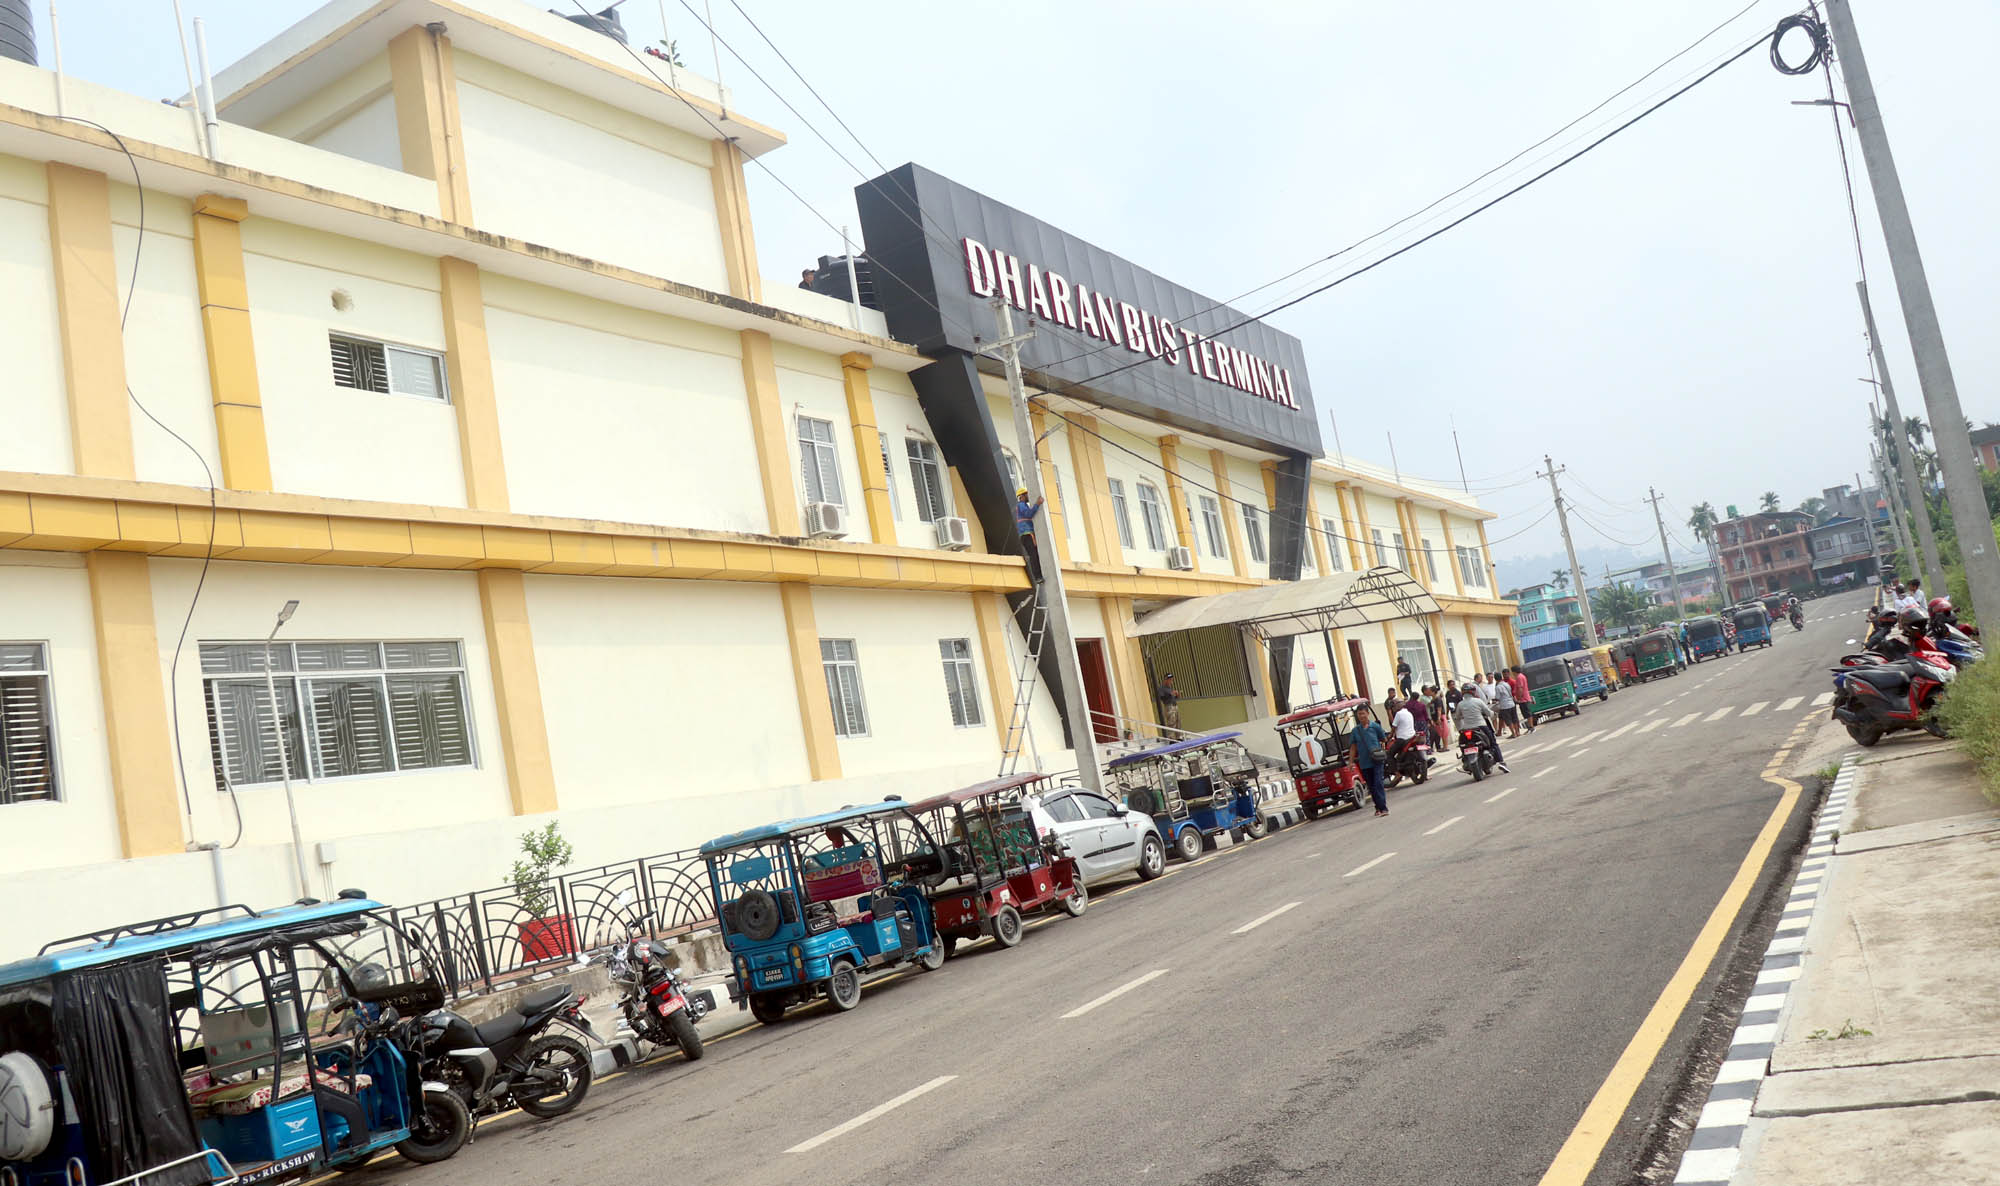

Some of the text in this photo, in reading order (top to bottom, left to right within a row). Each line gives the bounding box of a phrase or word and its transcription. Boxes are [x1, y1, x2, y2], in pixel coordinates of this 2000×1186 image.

[963, 237, 1301, 411] DHARAN BUS TERMINAL
